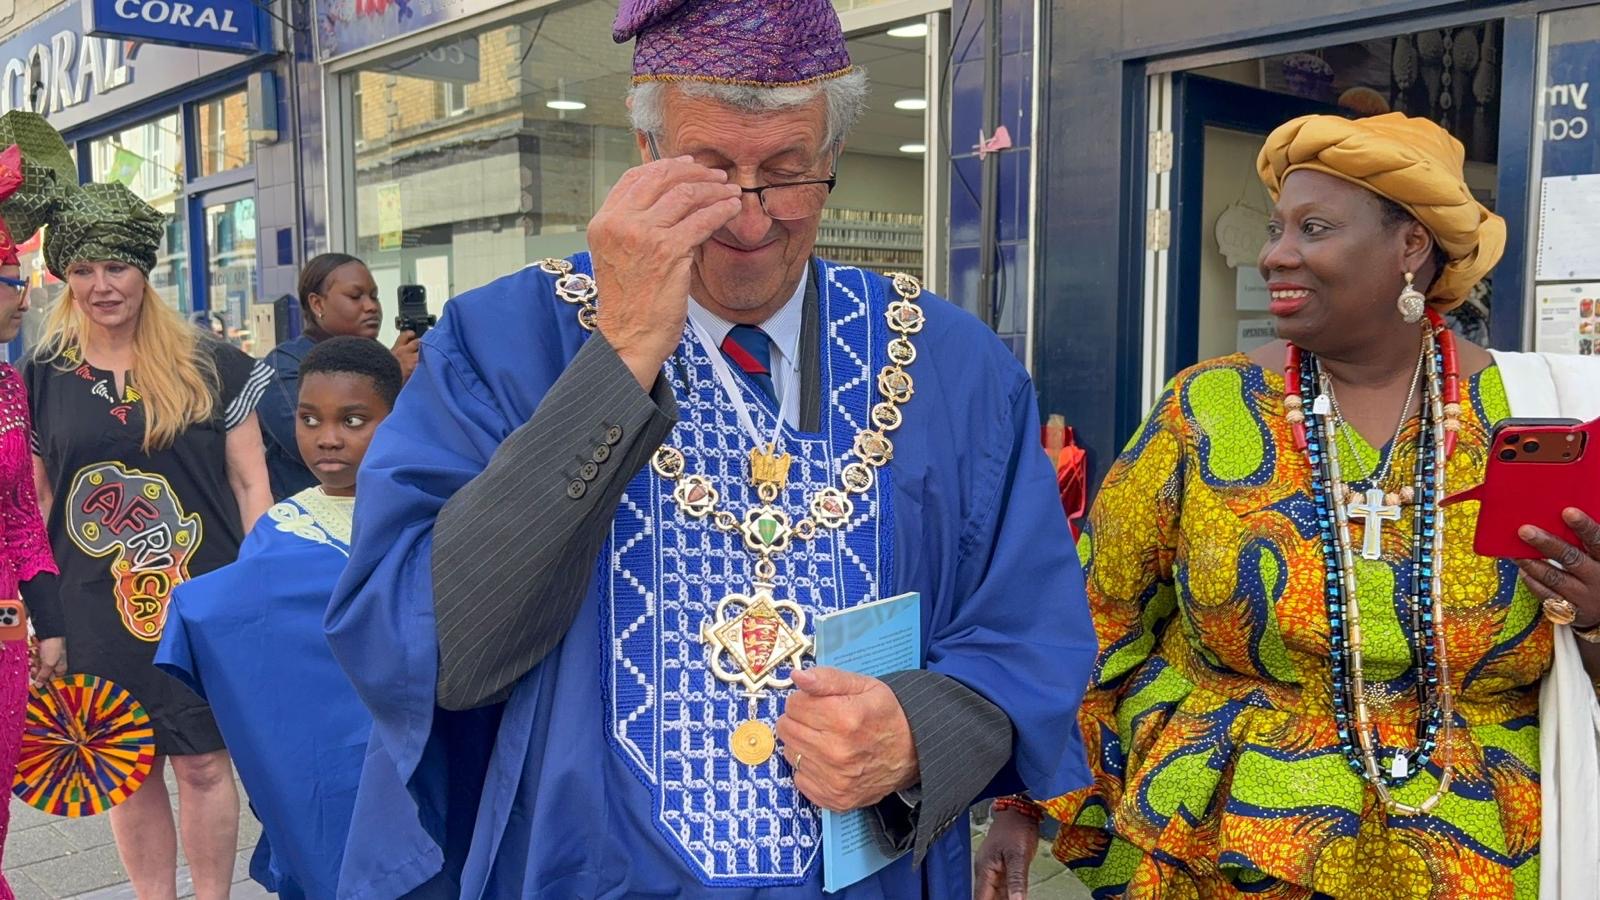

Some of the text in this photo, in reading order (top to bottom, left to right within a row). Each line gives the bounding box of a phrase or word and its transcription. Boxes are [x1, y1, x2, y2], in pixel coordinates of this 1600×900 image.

[114, 0, 239, 33] CORAL
[1, 30, 128, 115] CORAL
[81, 482, 174, 621] AFRICA
